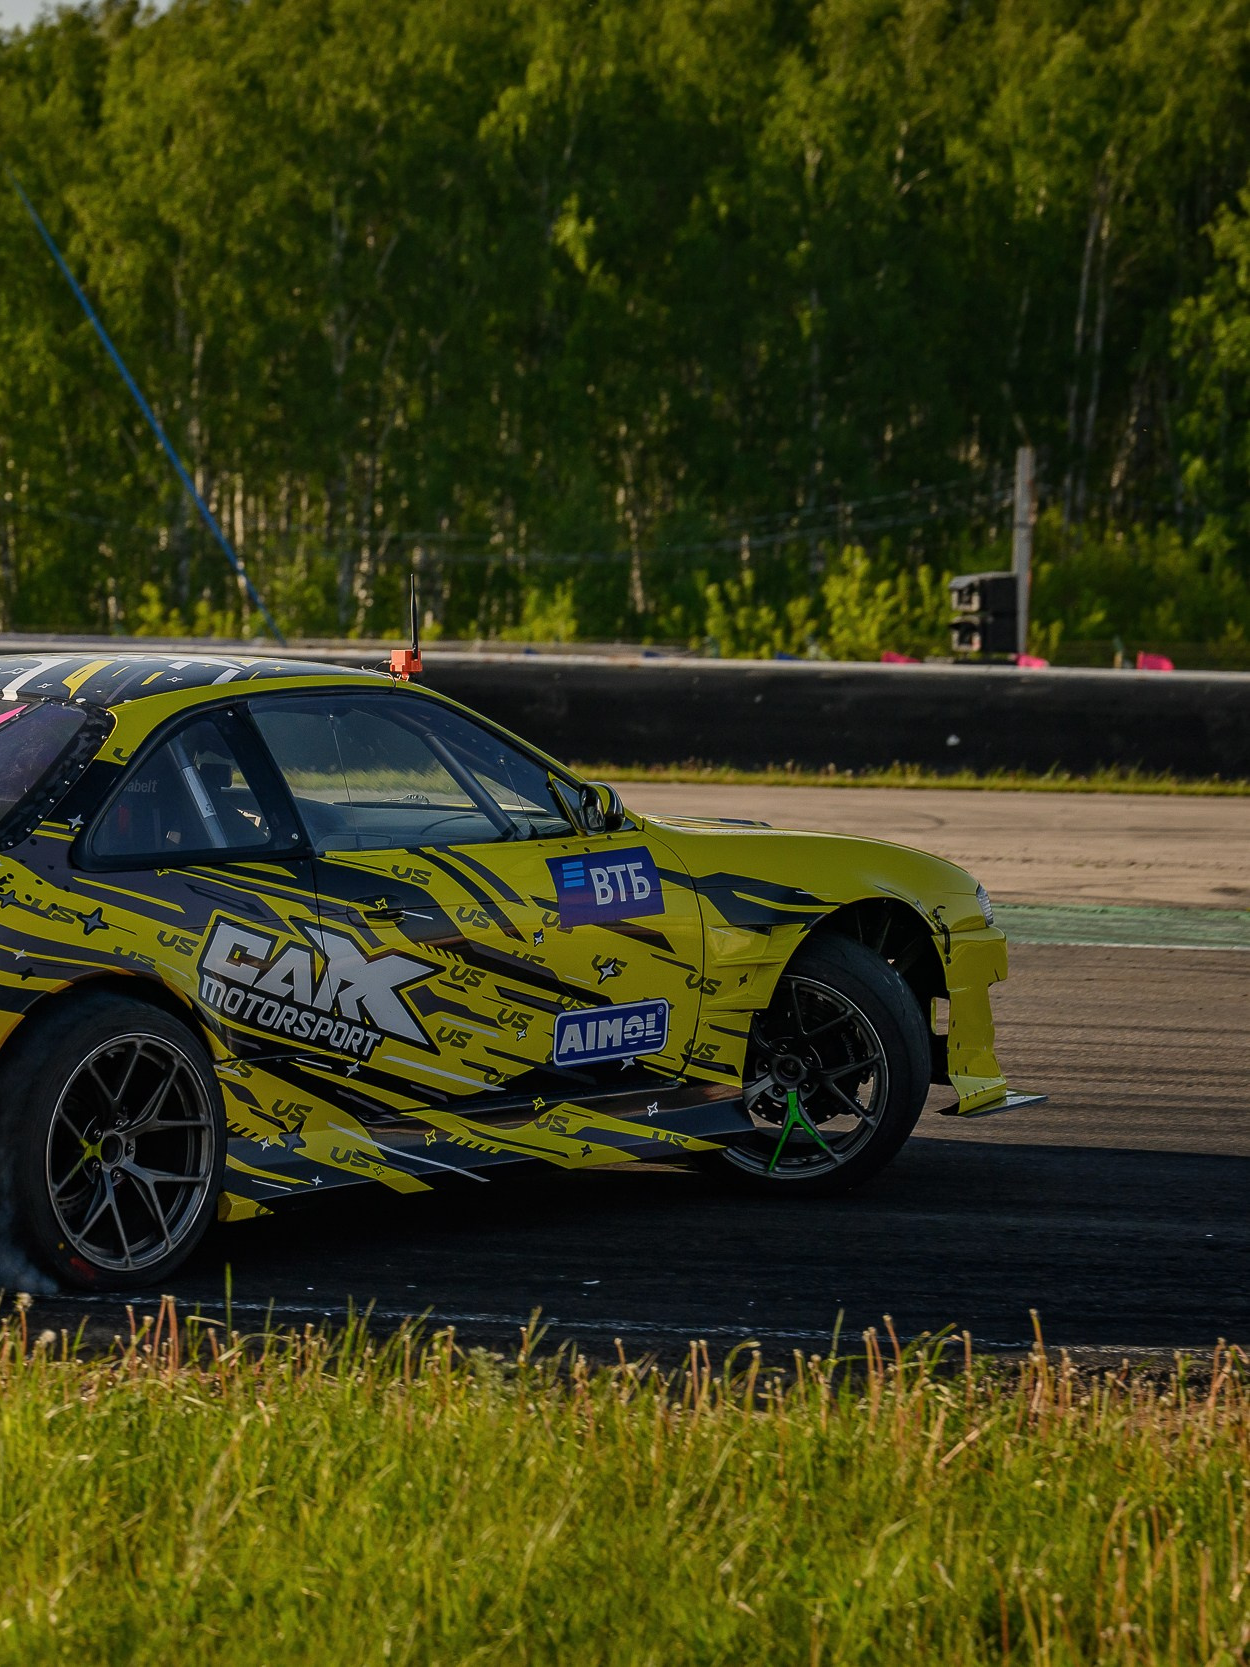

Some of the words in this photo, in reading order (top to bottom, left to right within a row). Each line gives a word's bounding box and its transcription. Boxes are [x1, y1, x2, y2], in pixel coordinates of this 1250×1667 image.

[123, 779, 158, 793] abelt
[590, 862, 651, 905] ВТБ
[201, 975, 382, 1056] MOTORSPORT
